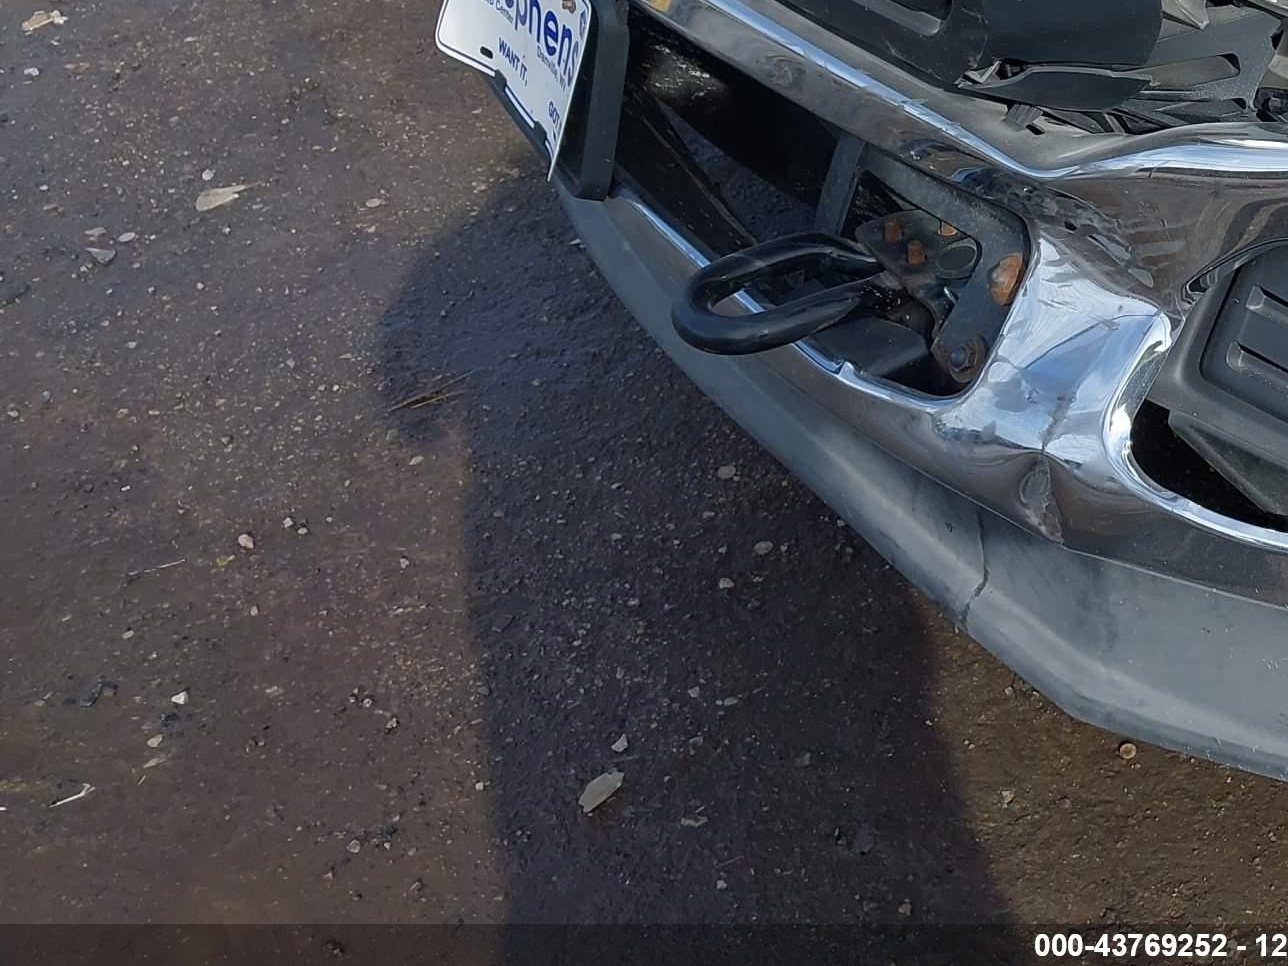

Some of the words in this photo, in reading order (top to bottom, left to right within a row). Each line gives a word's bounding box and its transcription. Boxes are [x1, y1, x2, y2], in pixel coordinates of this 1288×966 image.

[496, 0, 514, 24] Center
[499, 37, 520, 72] WANT
[519, 63, 528, 87] IT,
